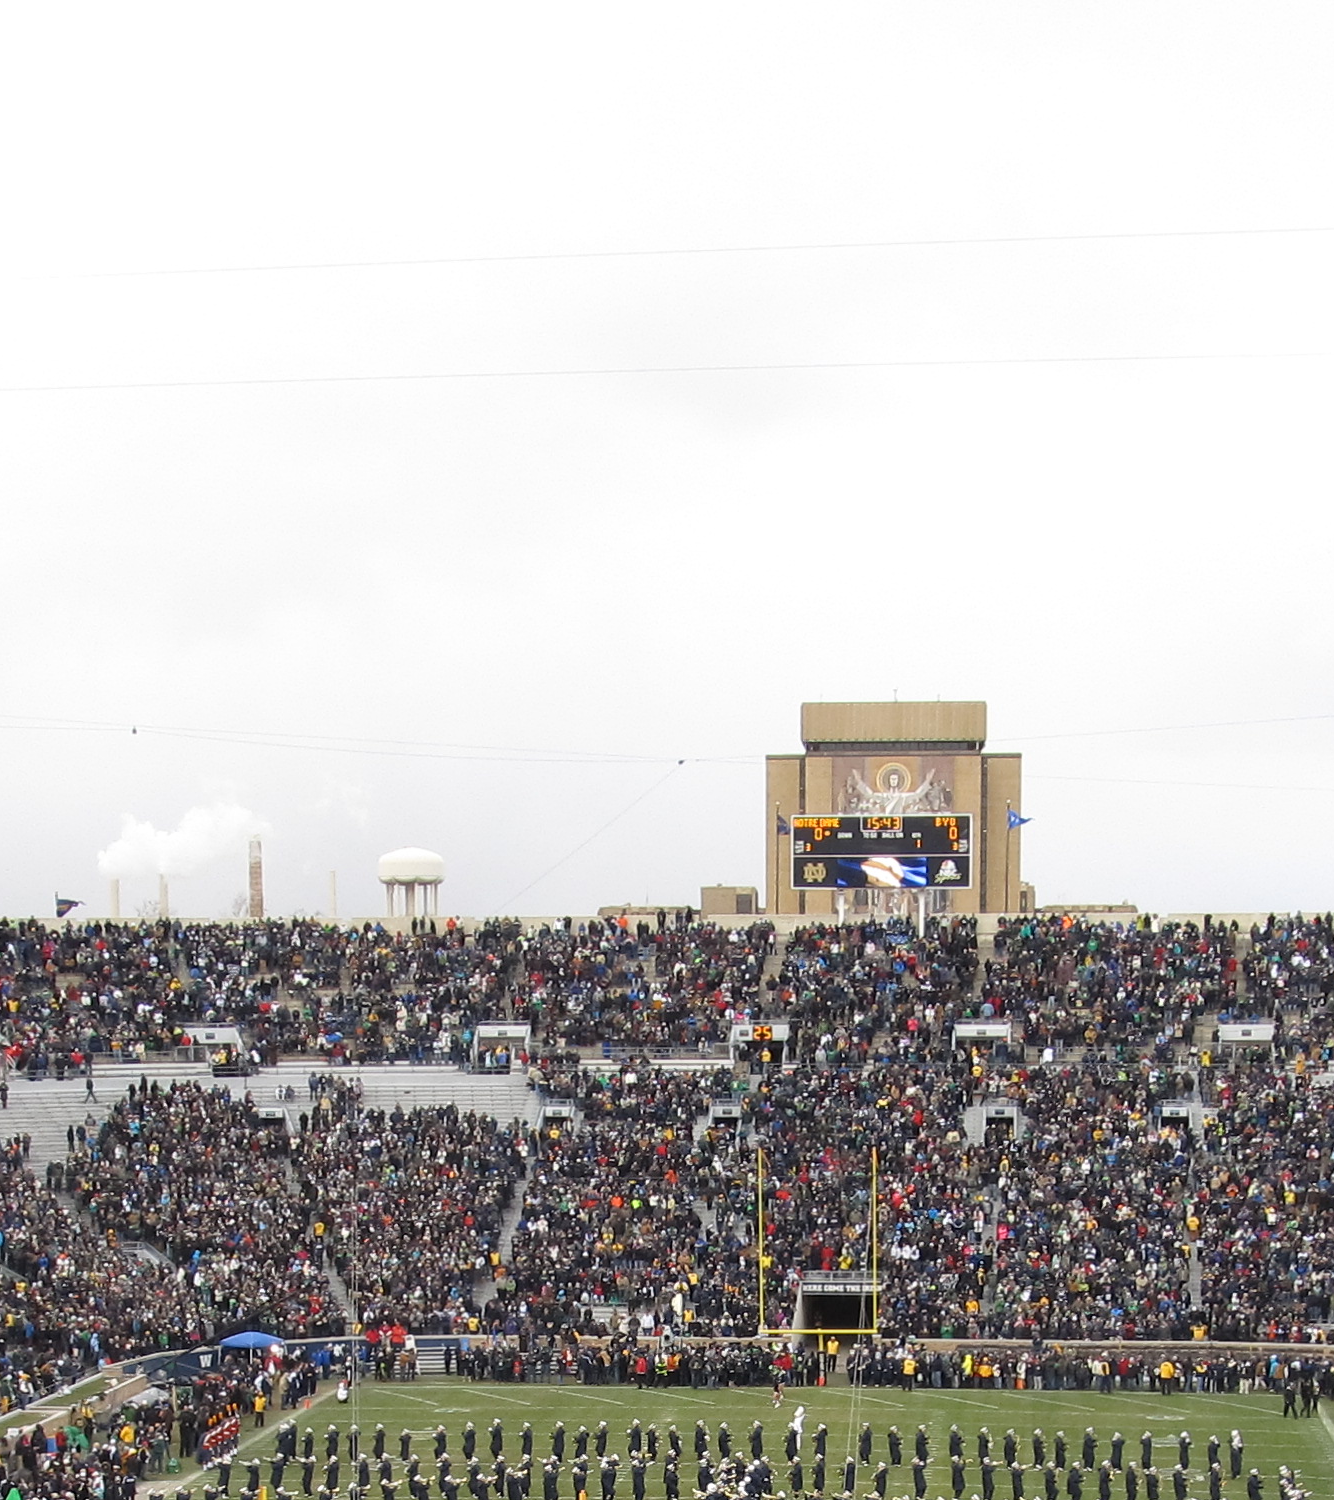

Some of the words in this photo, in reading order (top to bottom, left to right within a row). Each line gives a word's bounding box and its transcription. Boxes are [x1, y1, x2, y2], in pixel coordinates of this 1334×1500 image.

[793, 818, 818, 828] NOTRE
[819, 818, 841, 828] DAME
[867, 817, 900, 830] 15:43
[814, 828, 823, 841] 0
[949, 827, 958, 840] 0
[753, 1026, 772, 1040] 25
